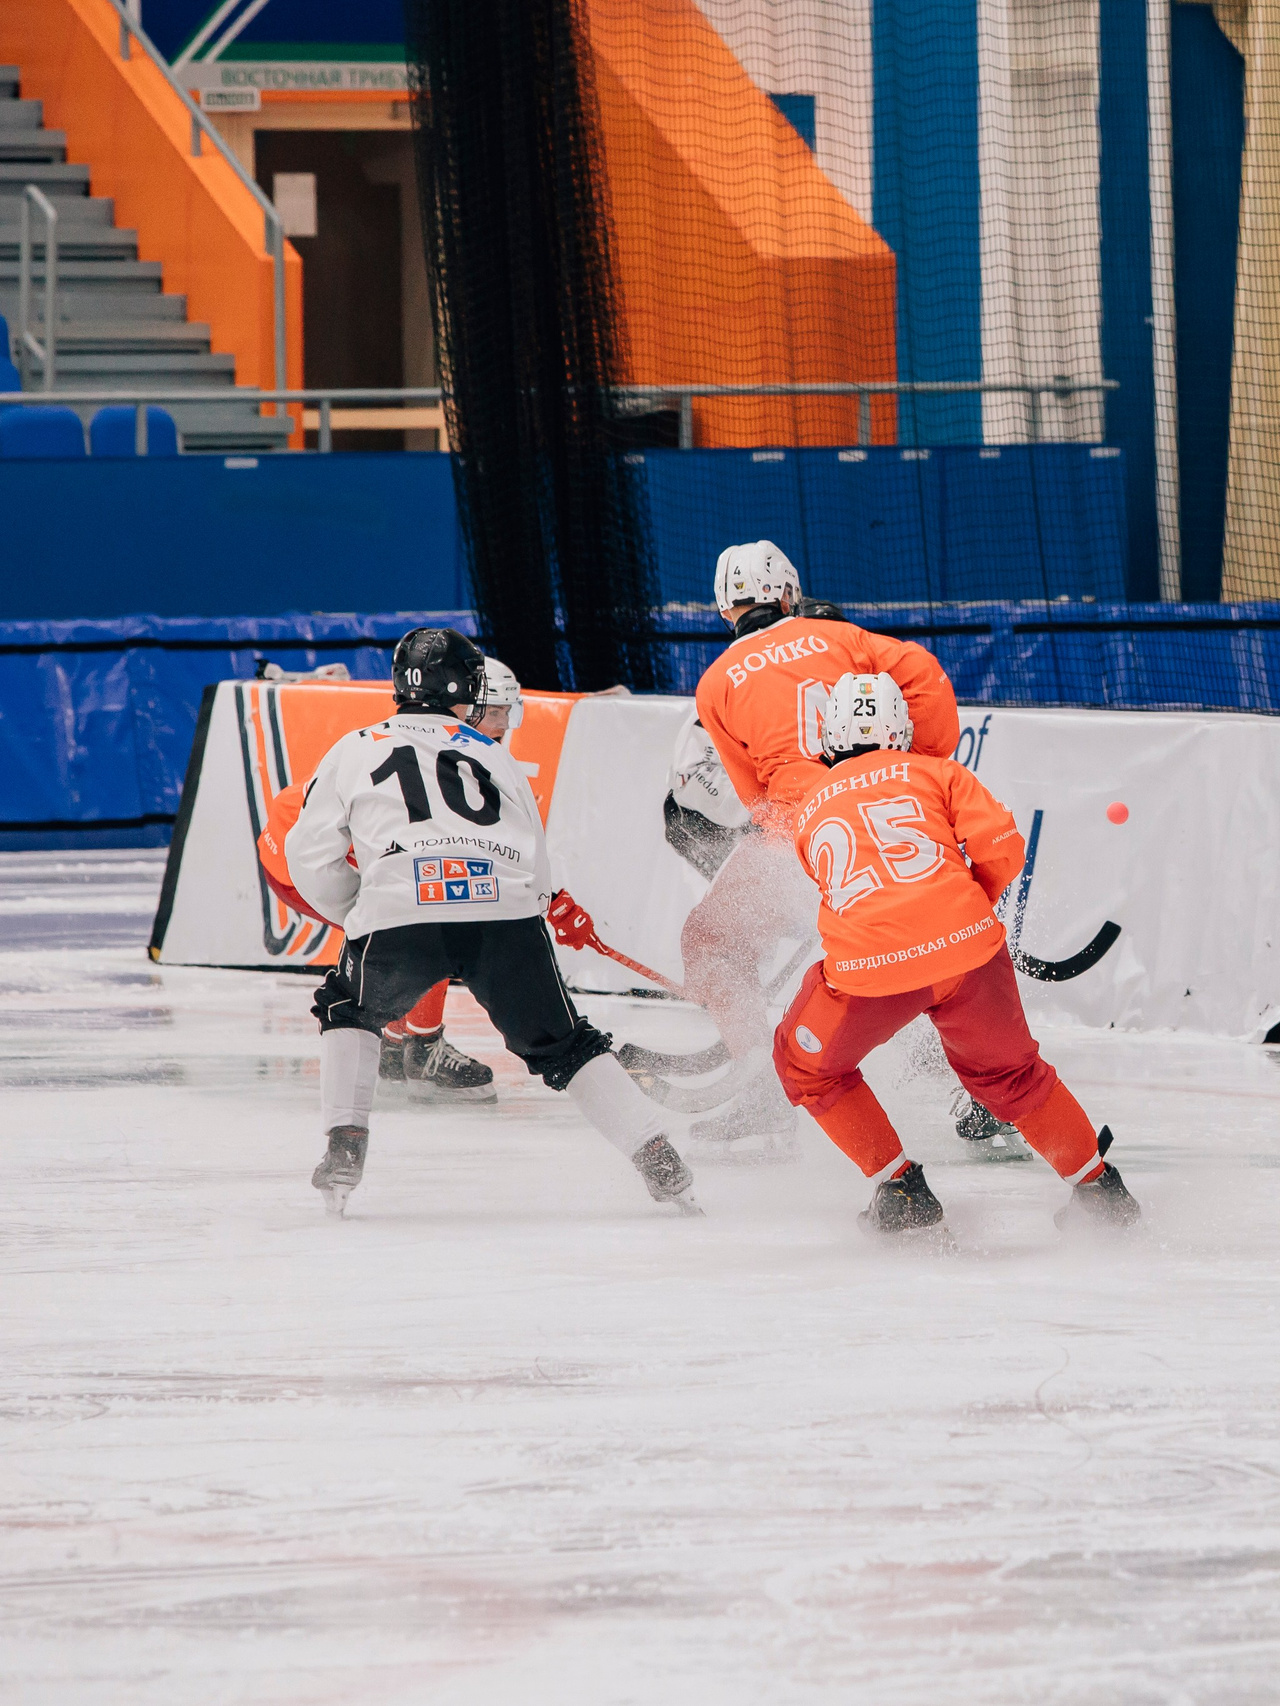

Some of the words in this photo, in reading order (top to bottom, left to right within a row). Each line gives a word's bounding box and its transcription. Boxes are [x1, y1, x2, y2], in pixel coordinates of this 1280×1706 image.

[221, 67, 342, 88] ВОСТОЧНАЯ
[733, 566, 742, 576] 4
[404, 667, 422, 687] 10
[725, 634, 829, 689] БОЙКО
[853, 698, 876, 717] 25
[370, 745, 501, 827] 10
[797, 762, 911, 833] ЗЕЛЕНИН
[413, 836, 521, 863] ПОЛИМЕТАЛЛ
[809, 795, 945, 916] 25
[836, 937, 948, 973] СВЕРДЛОВСКАЯ
[949, 916, 994, 944] ОБЛАСТЬ
